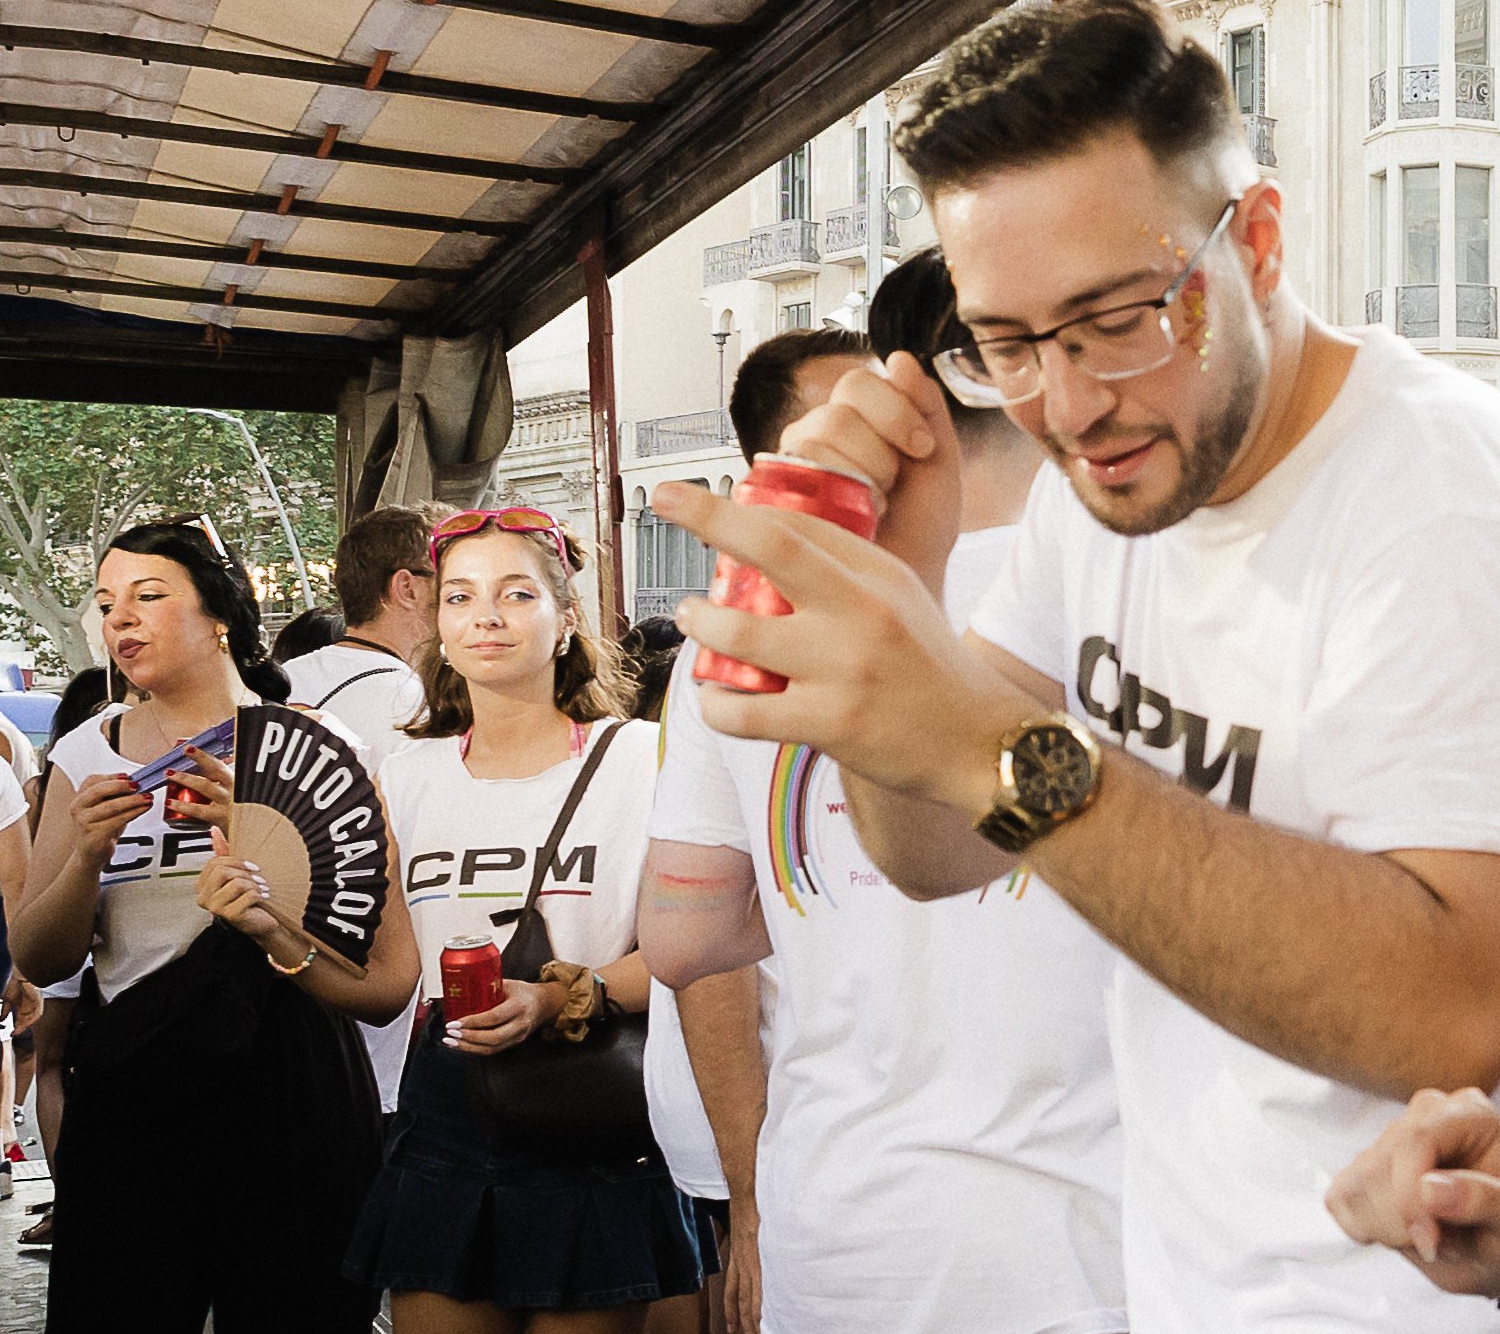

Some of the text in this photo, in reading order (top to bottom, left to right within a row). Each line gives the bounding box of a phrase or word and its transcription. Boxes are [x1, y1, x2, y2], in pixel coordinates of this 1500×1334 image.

[255, 720, 354, 811] PUTO
[1077, 635, 1263, 814] CPM
[406, 845, 597, 893] CPM
